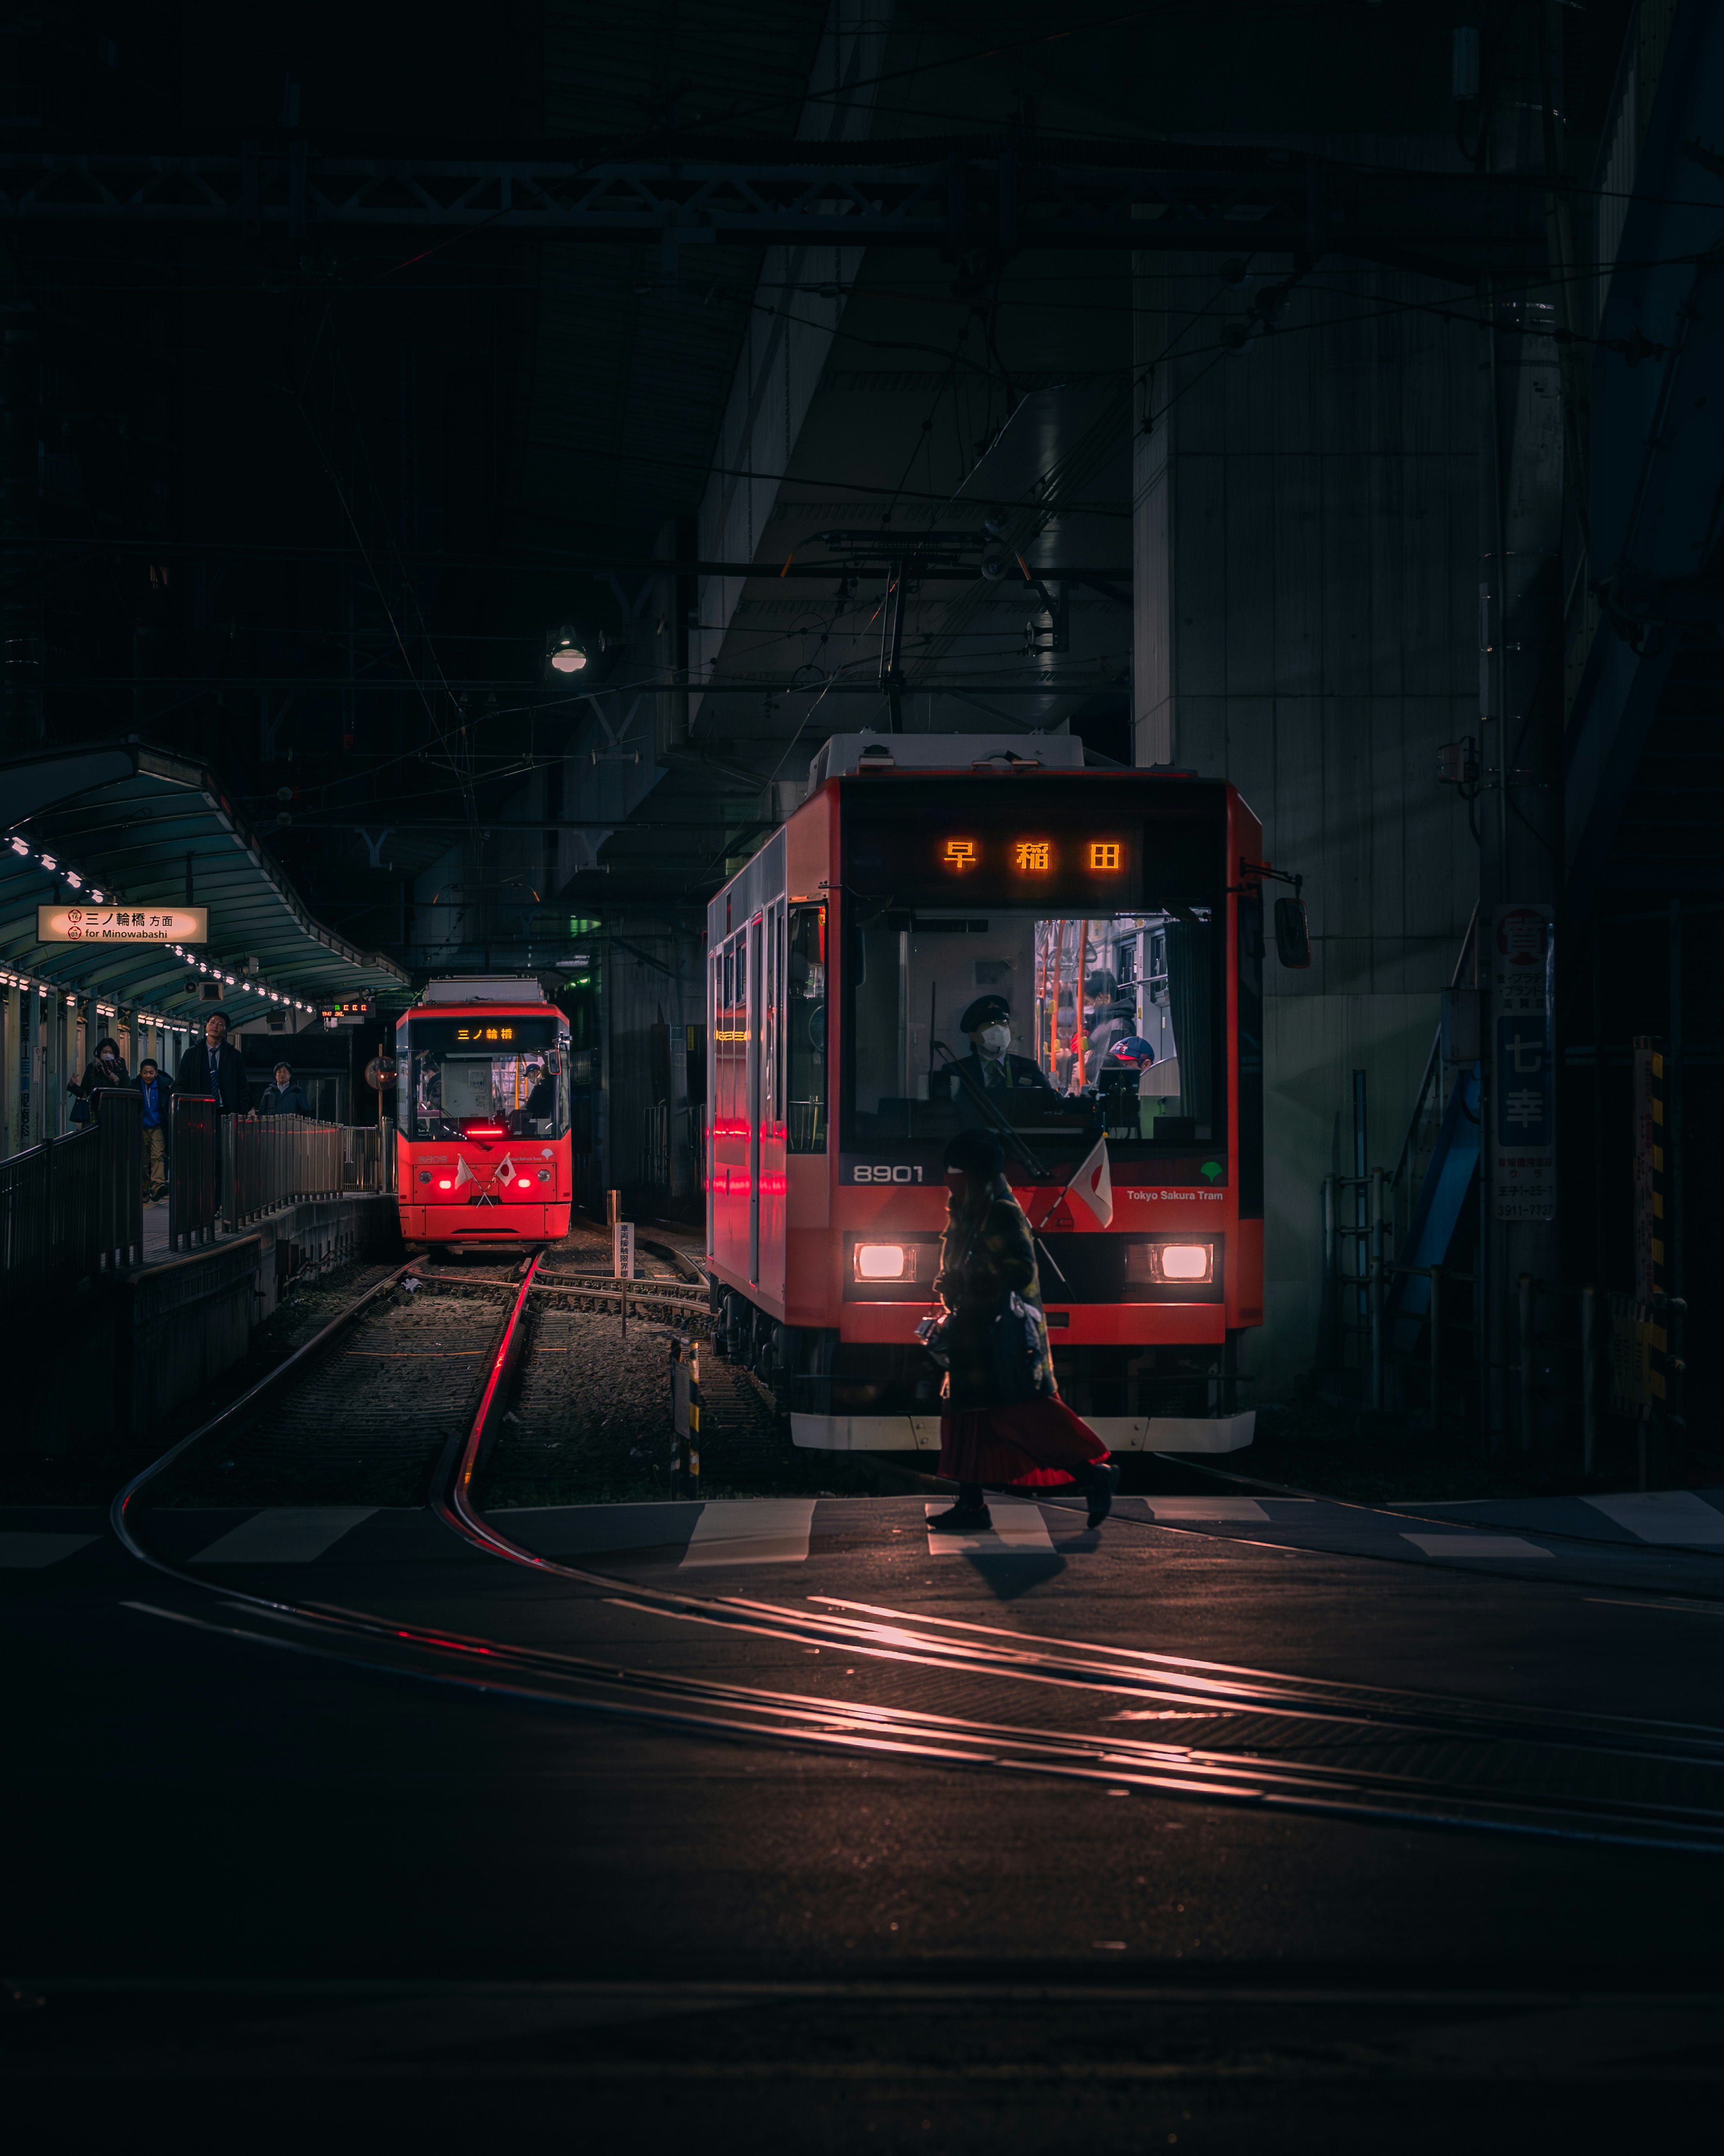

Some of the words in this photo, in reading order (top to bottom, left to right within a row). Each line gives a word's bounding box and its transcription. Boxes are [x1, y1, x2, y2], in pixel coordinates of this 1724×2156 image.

[944, 842, 1119, 869] 早稲田
[86, 913, 145, 926] 三ノ輪橋
[150, 916, 173, 926] 方面
[85, 929, 99, 937] for
[102, 930, 167, 939] Minowabashi
[1505, 1034, 1544, 1128] 七幸
[854, 1165, 923, 1182] 8901
[1127, 1190, 1158, 1202] Tokyo
[1160, 1190, 1196, 1200] Sakura
[1197, 1191, 1223, 1200] Tram
